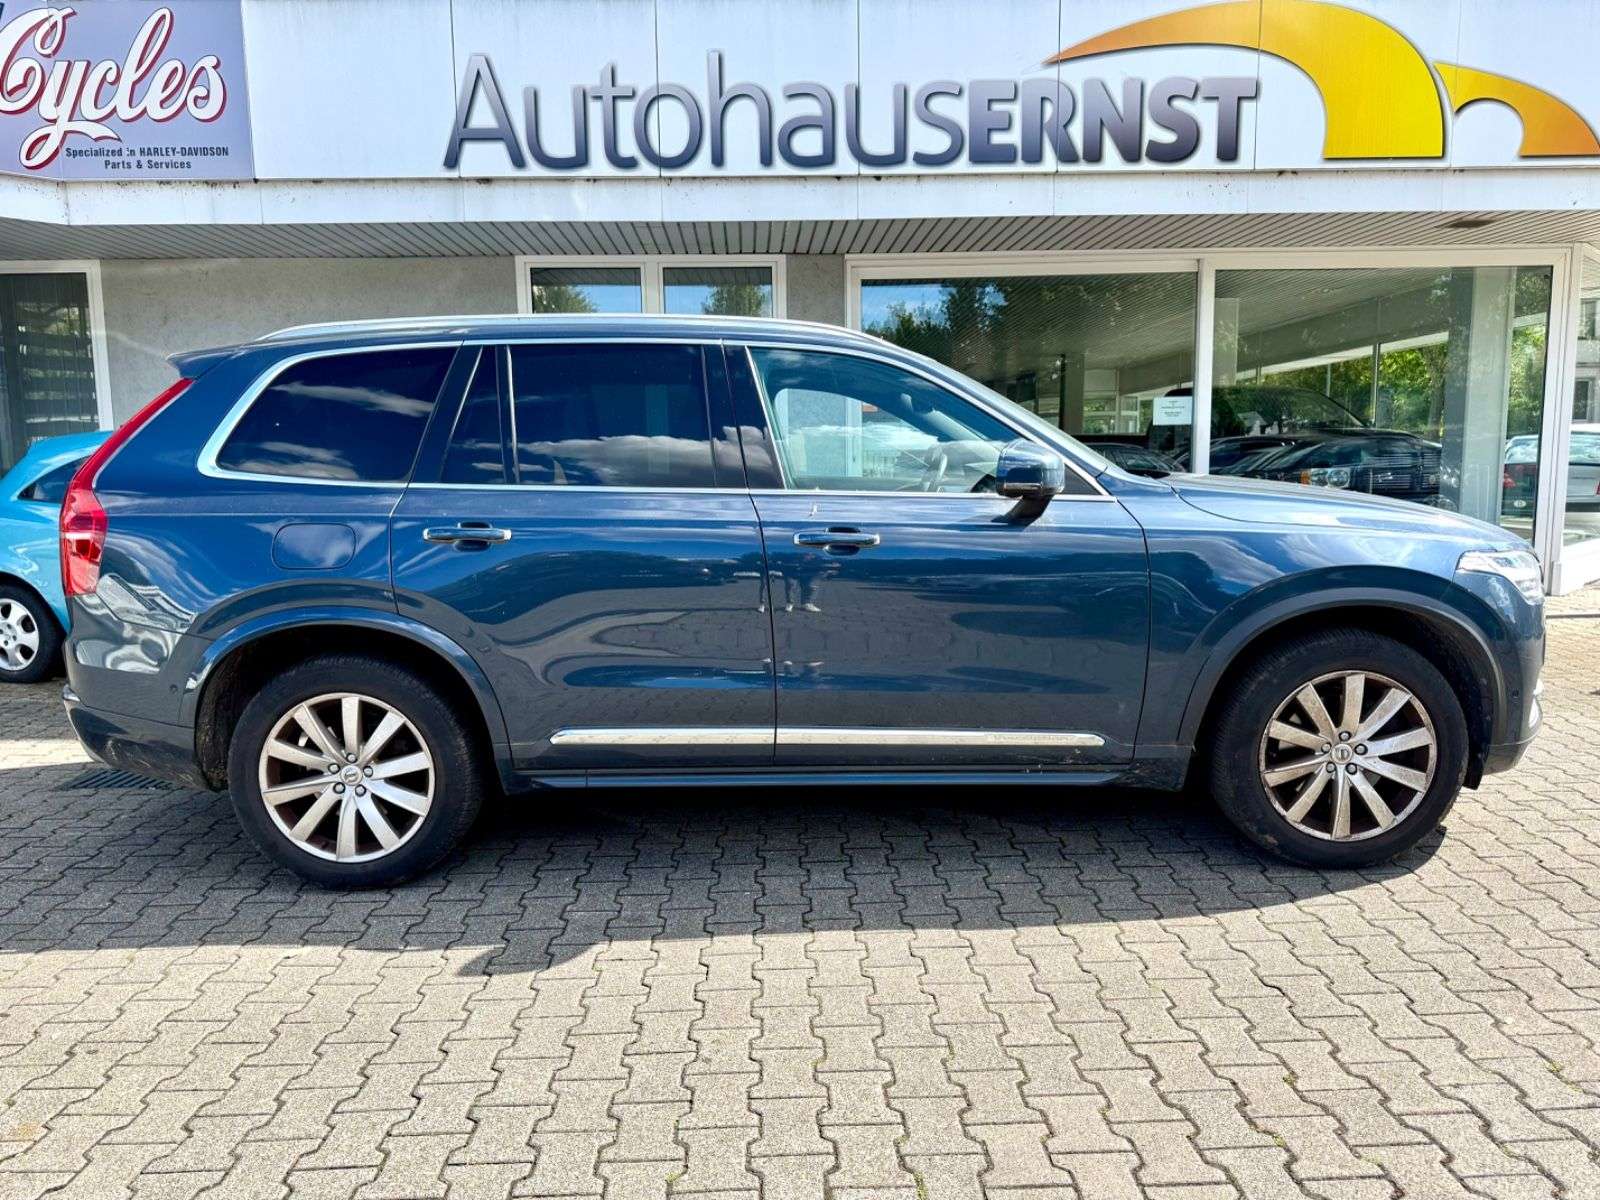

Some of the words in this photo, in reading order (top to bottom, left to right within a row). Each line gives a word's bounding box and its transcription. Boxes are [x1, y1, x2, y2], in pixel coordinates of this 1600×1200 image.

[0, 7, 227, 170] Cycles
[65, 147, 123, 158] Specialized
[139, 146, 229, 157] HARLEY-DAVIDSON
[104, 159, 132, 169] Parts
[136, 159, 143, 169] &
[147, 159, 192, 169] Services
